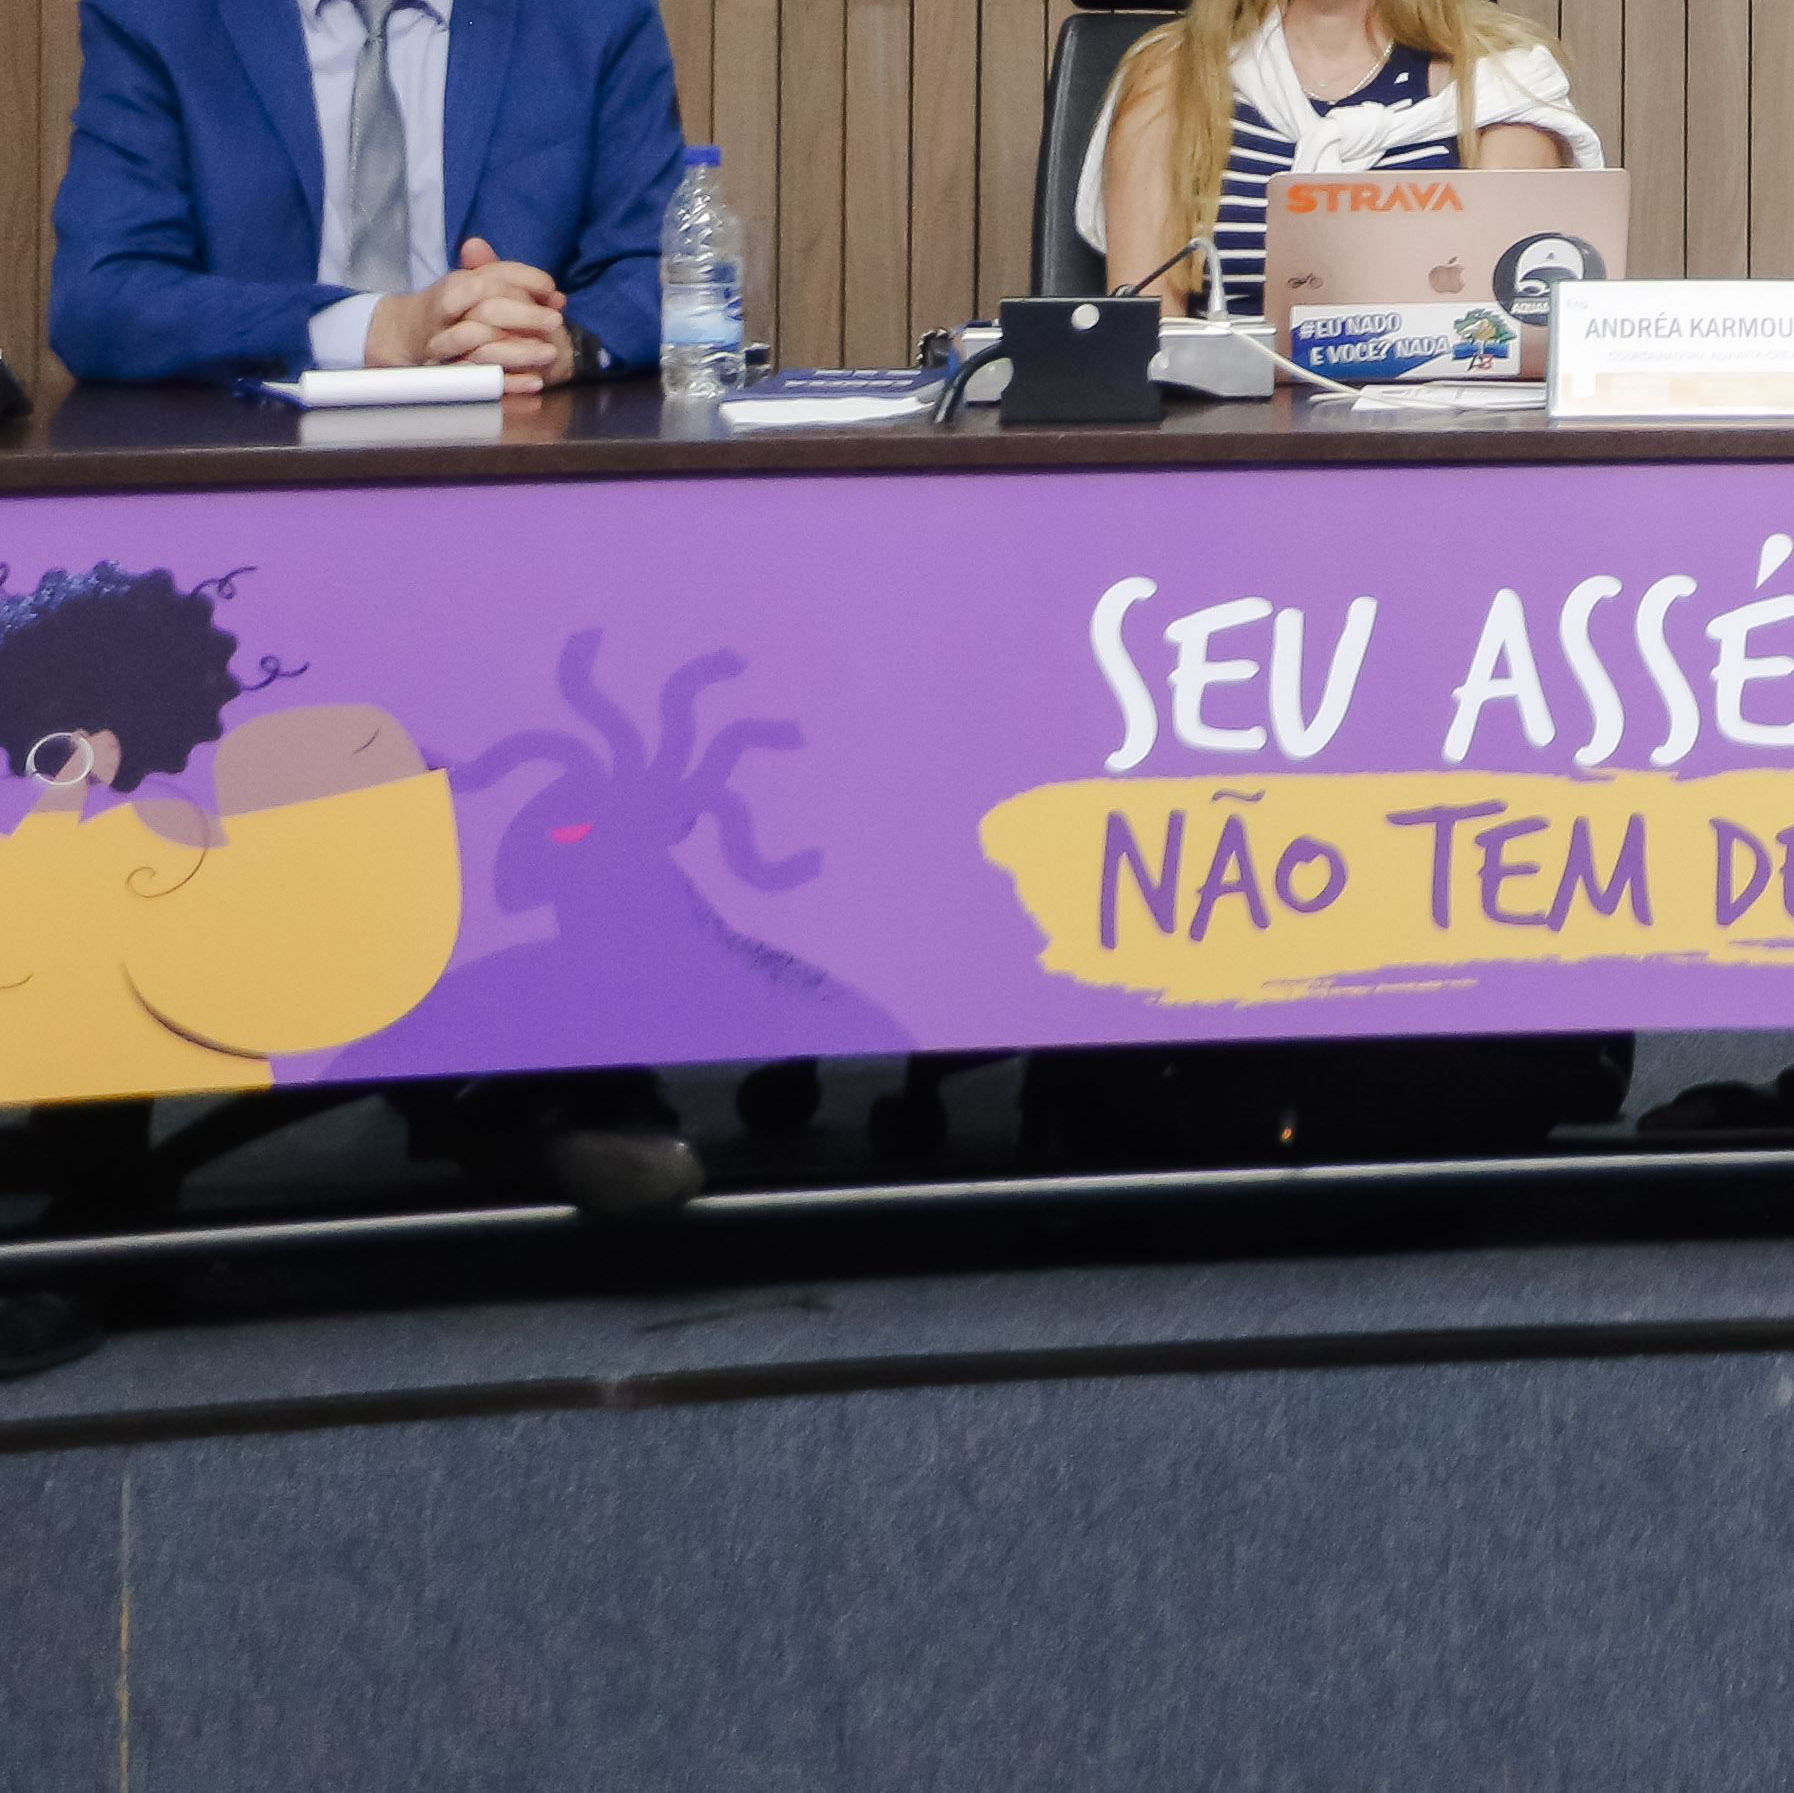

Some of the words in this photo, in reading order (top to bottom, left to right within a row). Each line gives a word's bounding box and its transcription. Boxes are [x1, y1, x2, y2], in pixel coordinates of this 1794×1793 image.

[1285, 182, 1463, 214] STRAVA
[1299, 317, 1341, 339] #EU
[1345, 313, 1400, 336] NADO
[1584, 311, 1683, 339] ANDRÉA
[1310, 346, 1324, 366] E
[1395, 336, 1449, 358] NADA
[1090, 576, 1379, 773] SEU
[1100, 790, 1348, 950] NÃO
[1387, 799, 1653, 929] TEM
